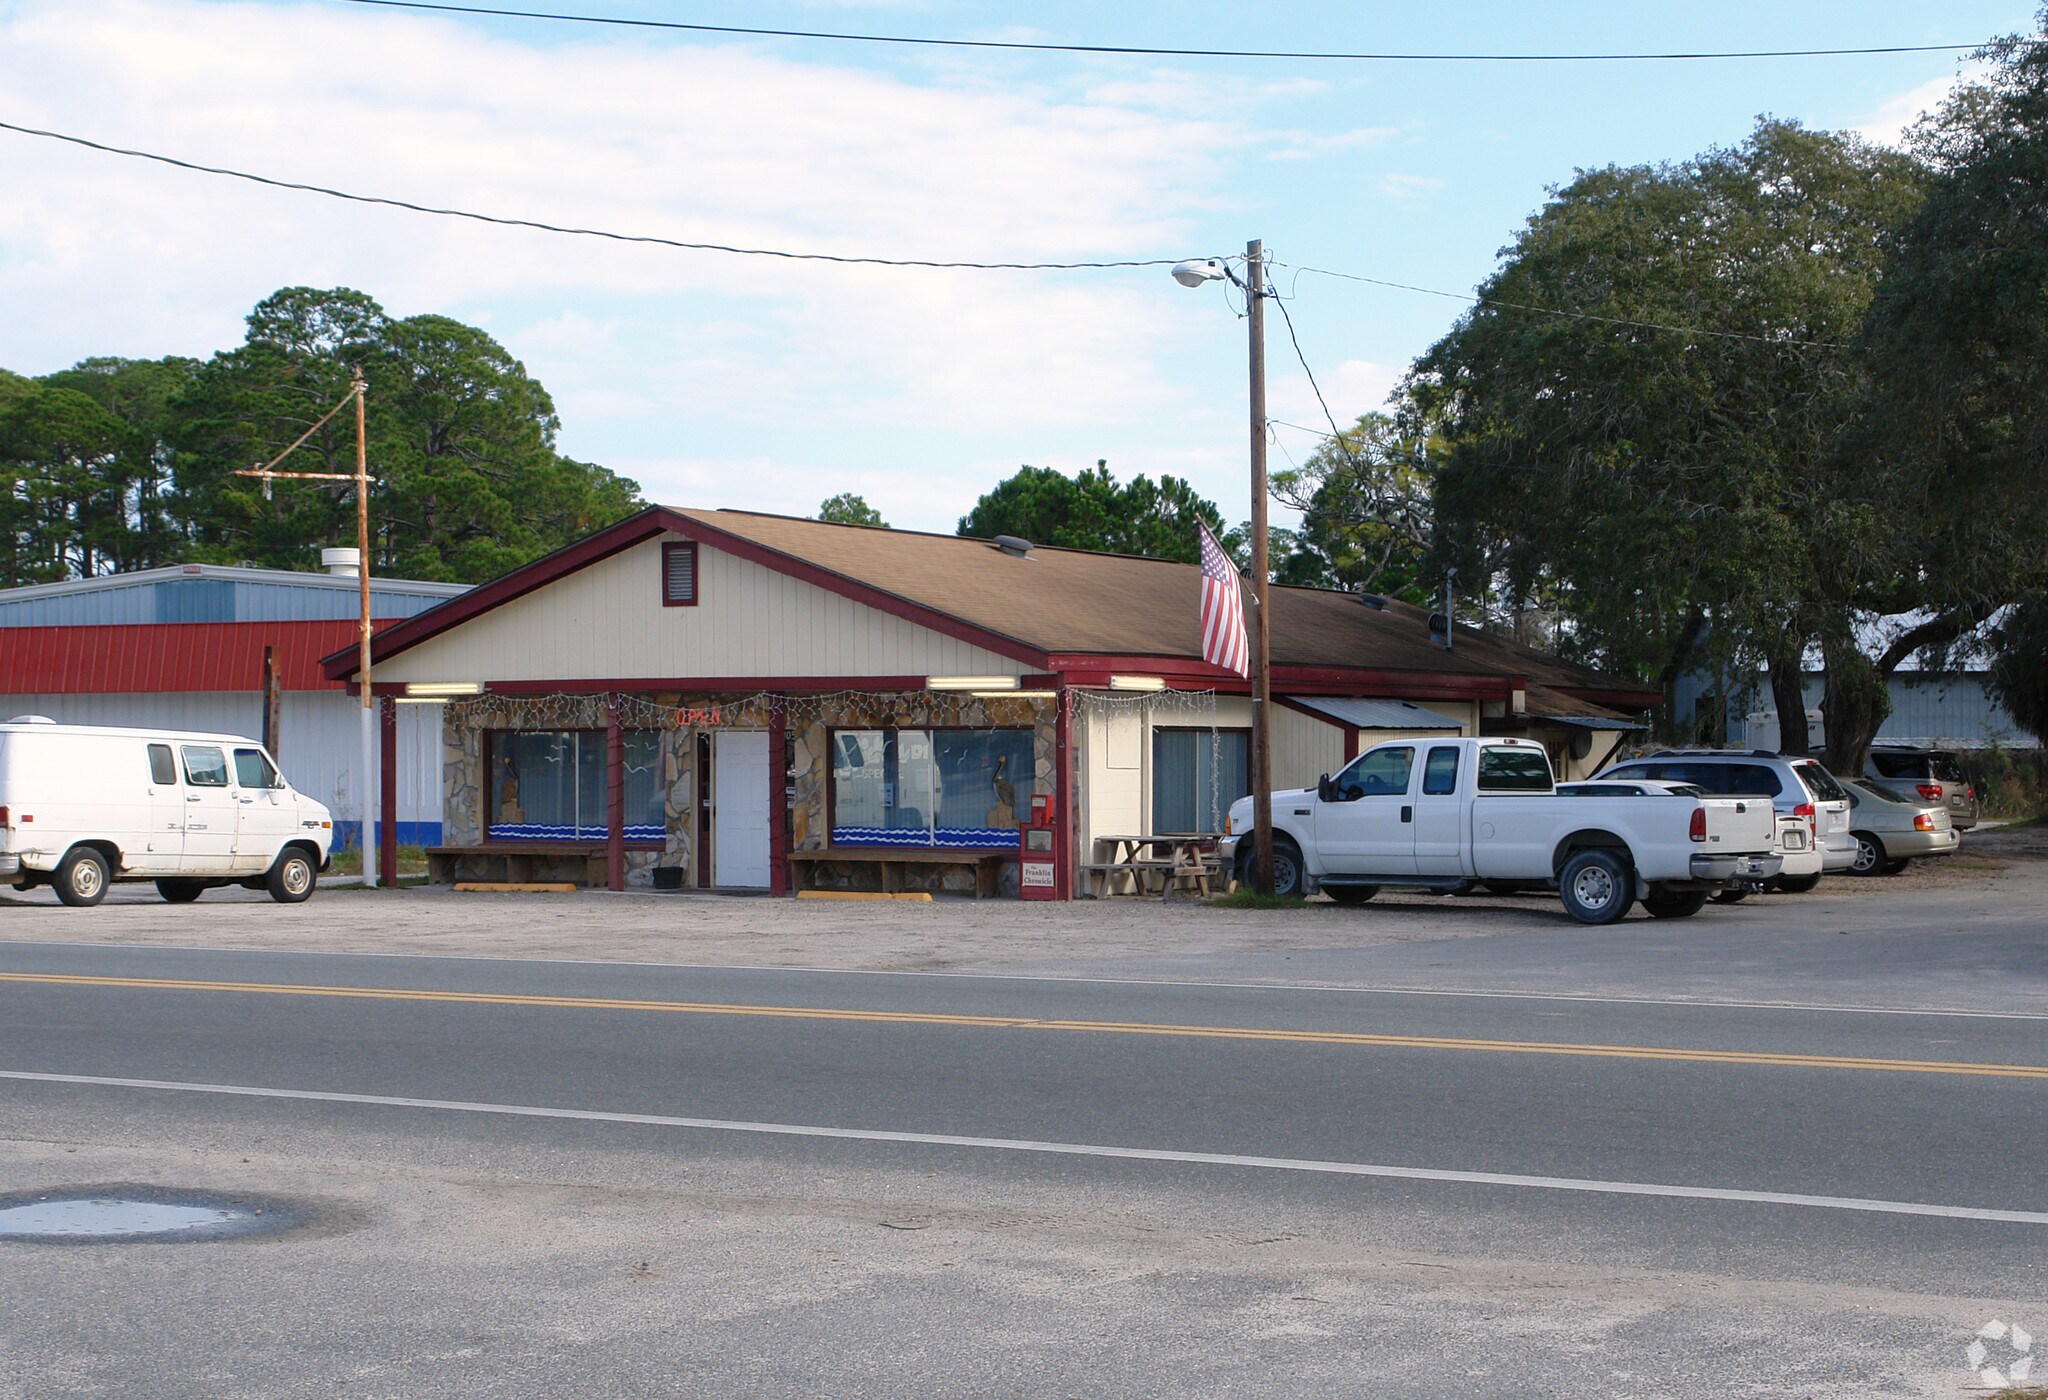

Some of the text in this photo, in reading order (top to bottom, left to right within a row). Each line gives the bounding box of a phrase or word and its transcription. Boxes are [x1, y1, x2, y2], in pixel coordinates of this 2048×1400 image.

[676, 708, 721, 726] OPEN
[1025, 868, 1051, 876] Franklin
[1024, 877, 1052, 885] Chronicle
